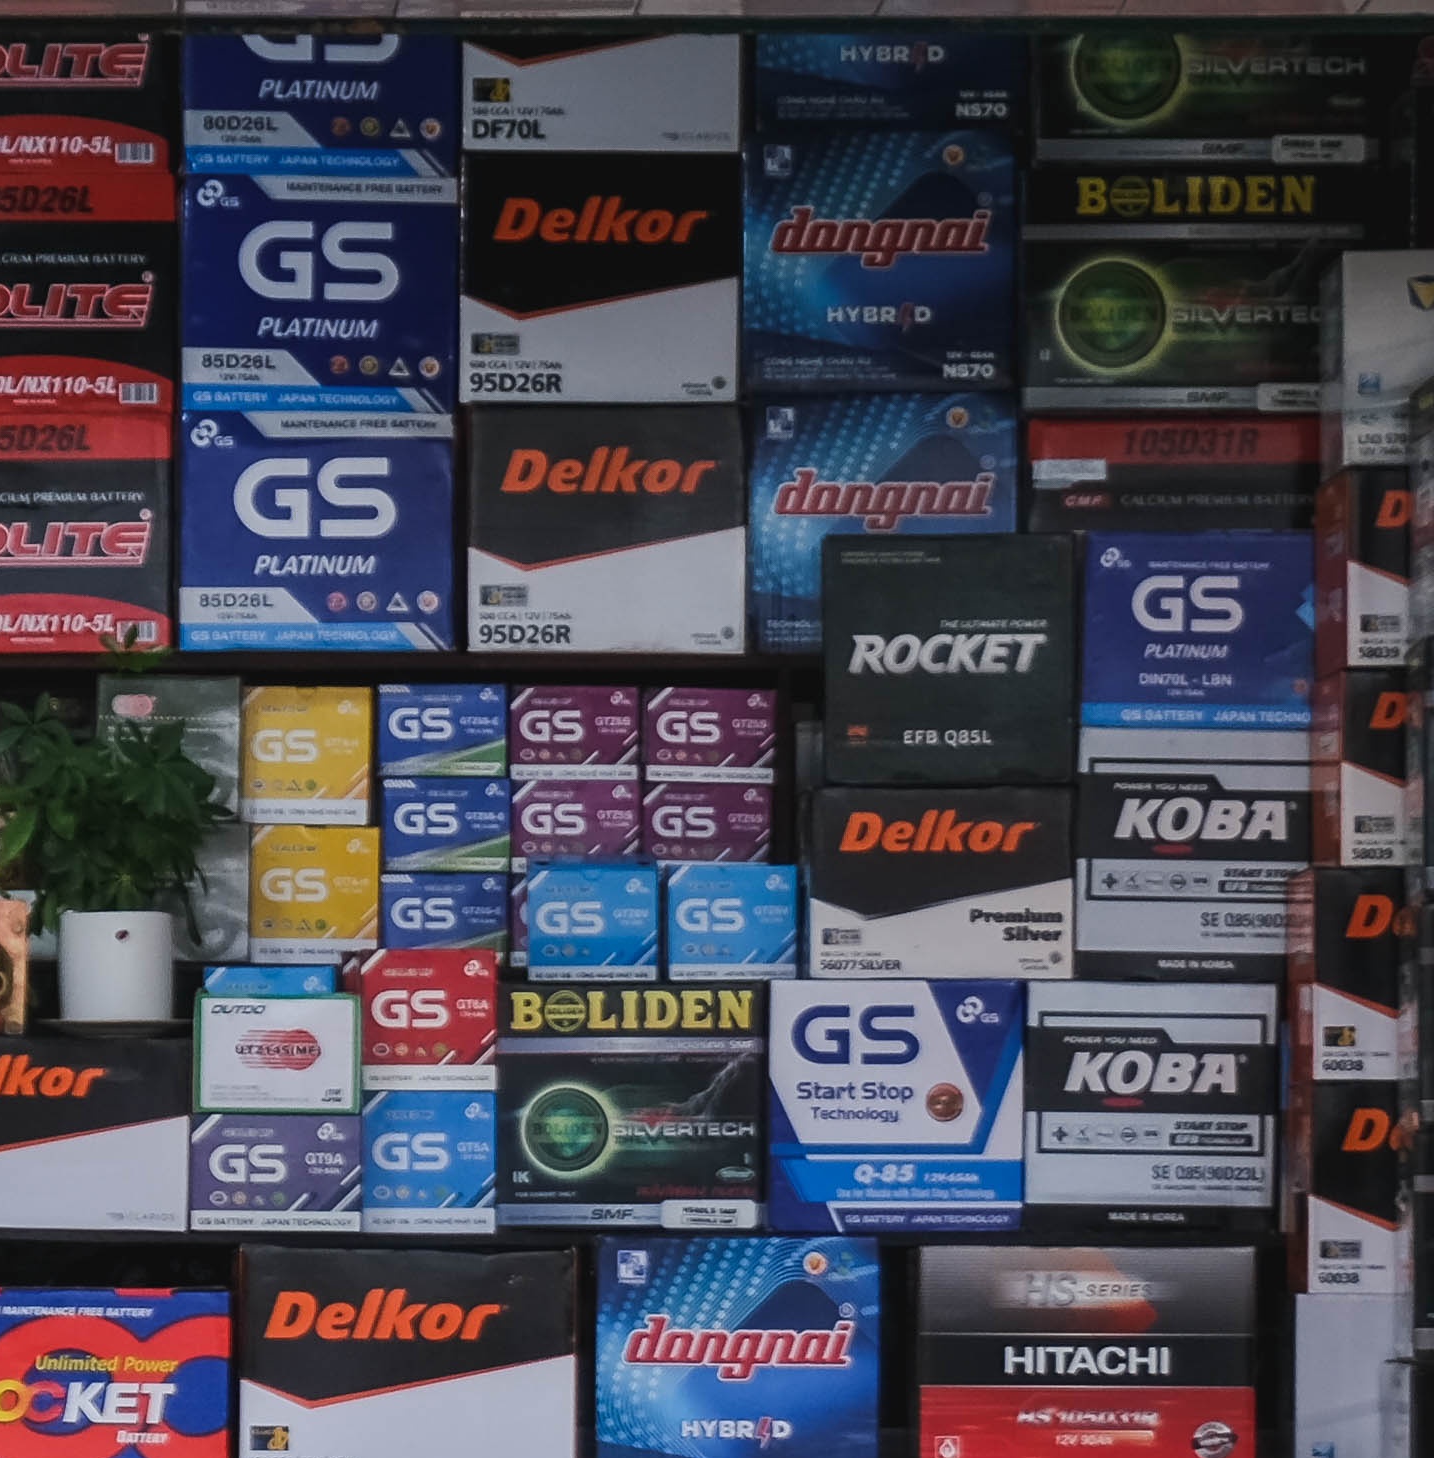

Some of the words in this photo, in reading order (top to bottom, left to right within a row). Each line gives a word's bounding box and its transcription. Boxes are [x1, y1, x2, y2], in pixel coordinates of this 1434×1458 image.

[1188, 56, 1367, 77] SILVERTECH
[472, 119, 546, 141] DF70L
[217, 153, 270, 165] BATTERY
[280, 154, 316, 166] JAPAN
[320, 155, 399, 167] TECHNOLOGY
[1076, 174, 1316, 216] BOLIDEN
[238, 220, 401, 301] GS
[942, 362, 994, 380] NS70
[470, 373, 562, 395] 95D26R
[1124, 428, 1259, 457] 105D31R
[253, 554, 376, 577] PLATINUM
[478, 623, 570, 646] 95D26R
[847, 633, 1047, 676] ROCKET
[904, 730, 938, 746] EFB
[944, 730, 992, 748] Q85L
[969, 909, 1063, 928] Premium
[1002, 924, 1063, 945] Silver
[820, 959, 856, 973] 56077
[858, 959, 902, 973] SILVER
[511, 991, 753, 1032] BOLIDEN
[1063, 1050, 1240, 1094] KOBA
[796, 1082, 855, 1102] Start
[861, 1080, 914, 1104] Stop
[811, 1106, 899, 1125] Technology
[612, 1122, 755, 1138] SILVERTECH
[1108, 1212, 1134, 1221] MADE
[1153, 1213, 1184, 1222] KOREA
[2, 1305, 74, 1317] MAINTENANCE
[77, 1306, 103, 1317] FREE
[106, 1307, 153, 1318] BATTERY
[264, 1287, 501, 1342] Delkor
[35, 1355, 119, 1373] Unlimited
[124, 1356, 178, 1375] Power
[1003, 1345, 1171, 1376] HITACHI
